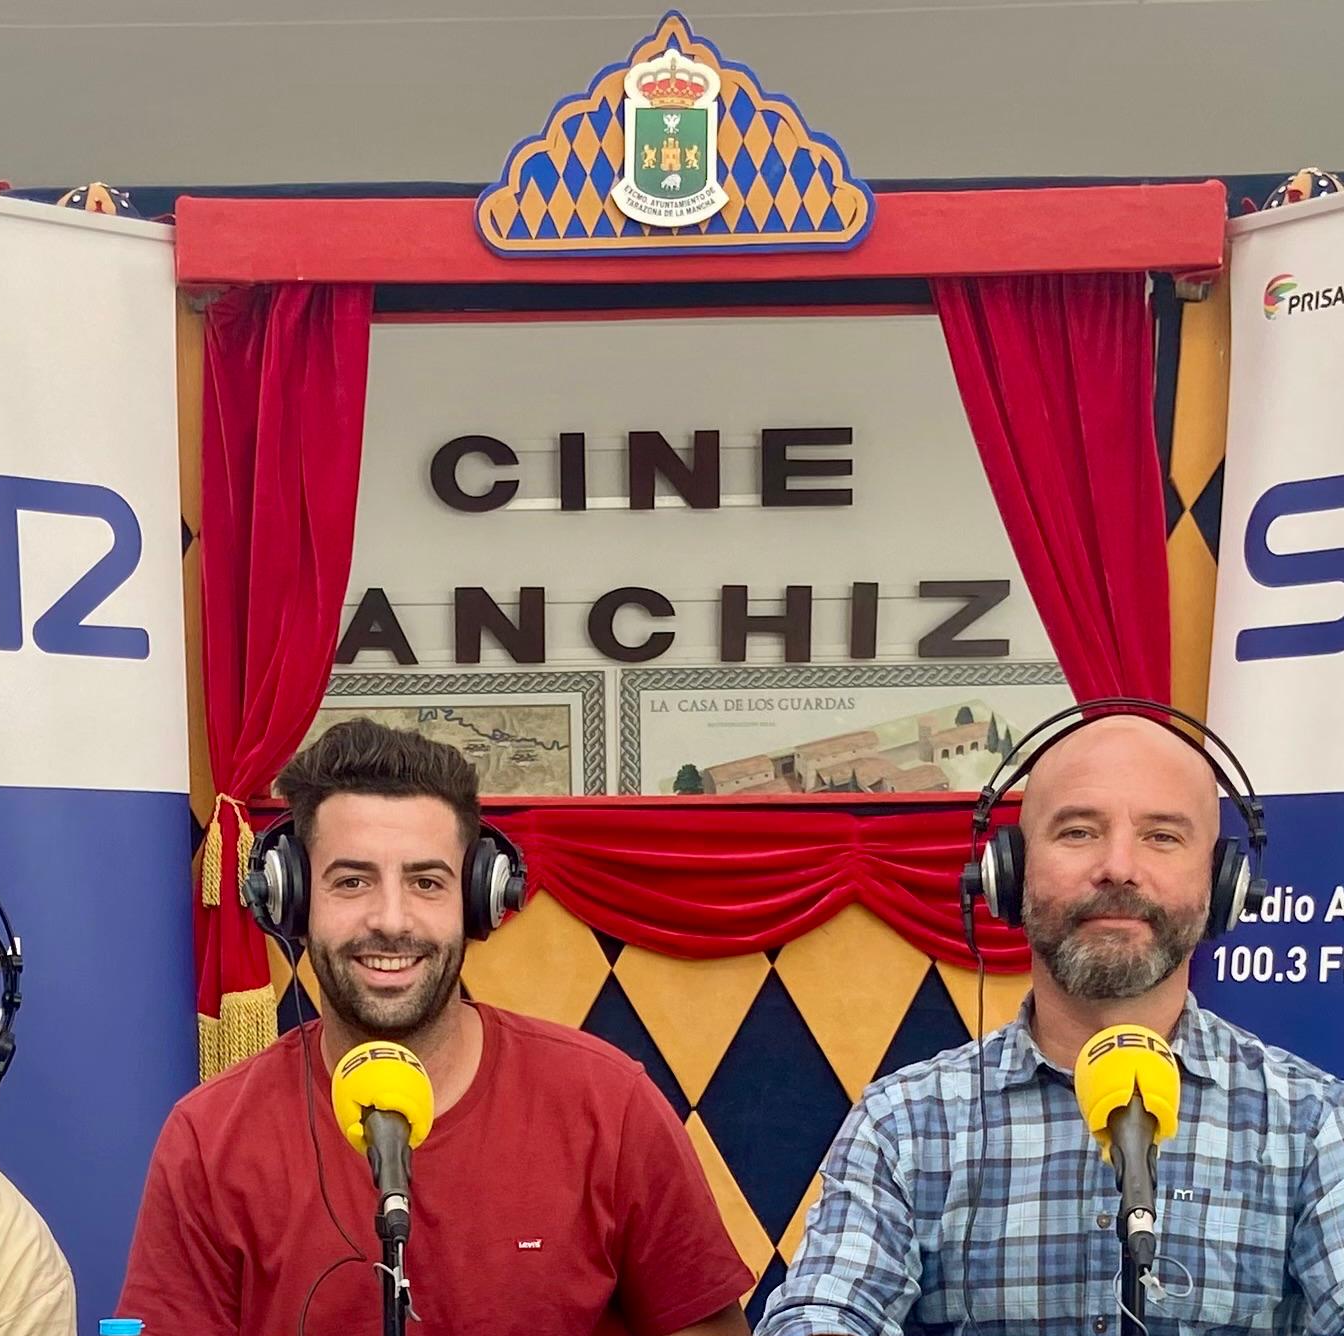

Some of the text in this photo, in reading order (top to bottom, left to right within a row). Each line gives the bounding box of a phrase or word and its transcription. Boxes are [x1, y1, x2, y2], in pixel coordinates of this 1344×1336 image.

[624, 184, 716, 209] EXCMO. AYUNTAMIENTO DE
[626, 197, 716, 217] TARAZONA DE LA MANCHA
[429, 426, 854, 513] CINE
[333, 578, 1011, 665] ANCHIZ
[650, 697, 856, 713] LA CASA DE LOS GUARDAS
[1213, 945, 1308, 983] 100.3
[341, 1047, 426, 1080] SER
[1087, 1033, 1175, 1067] SER
